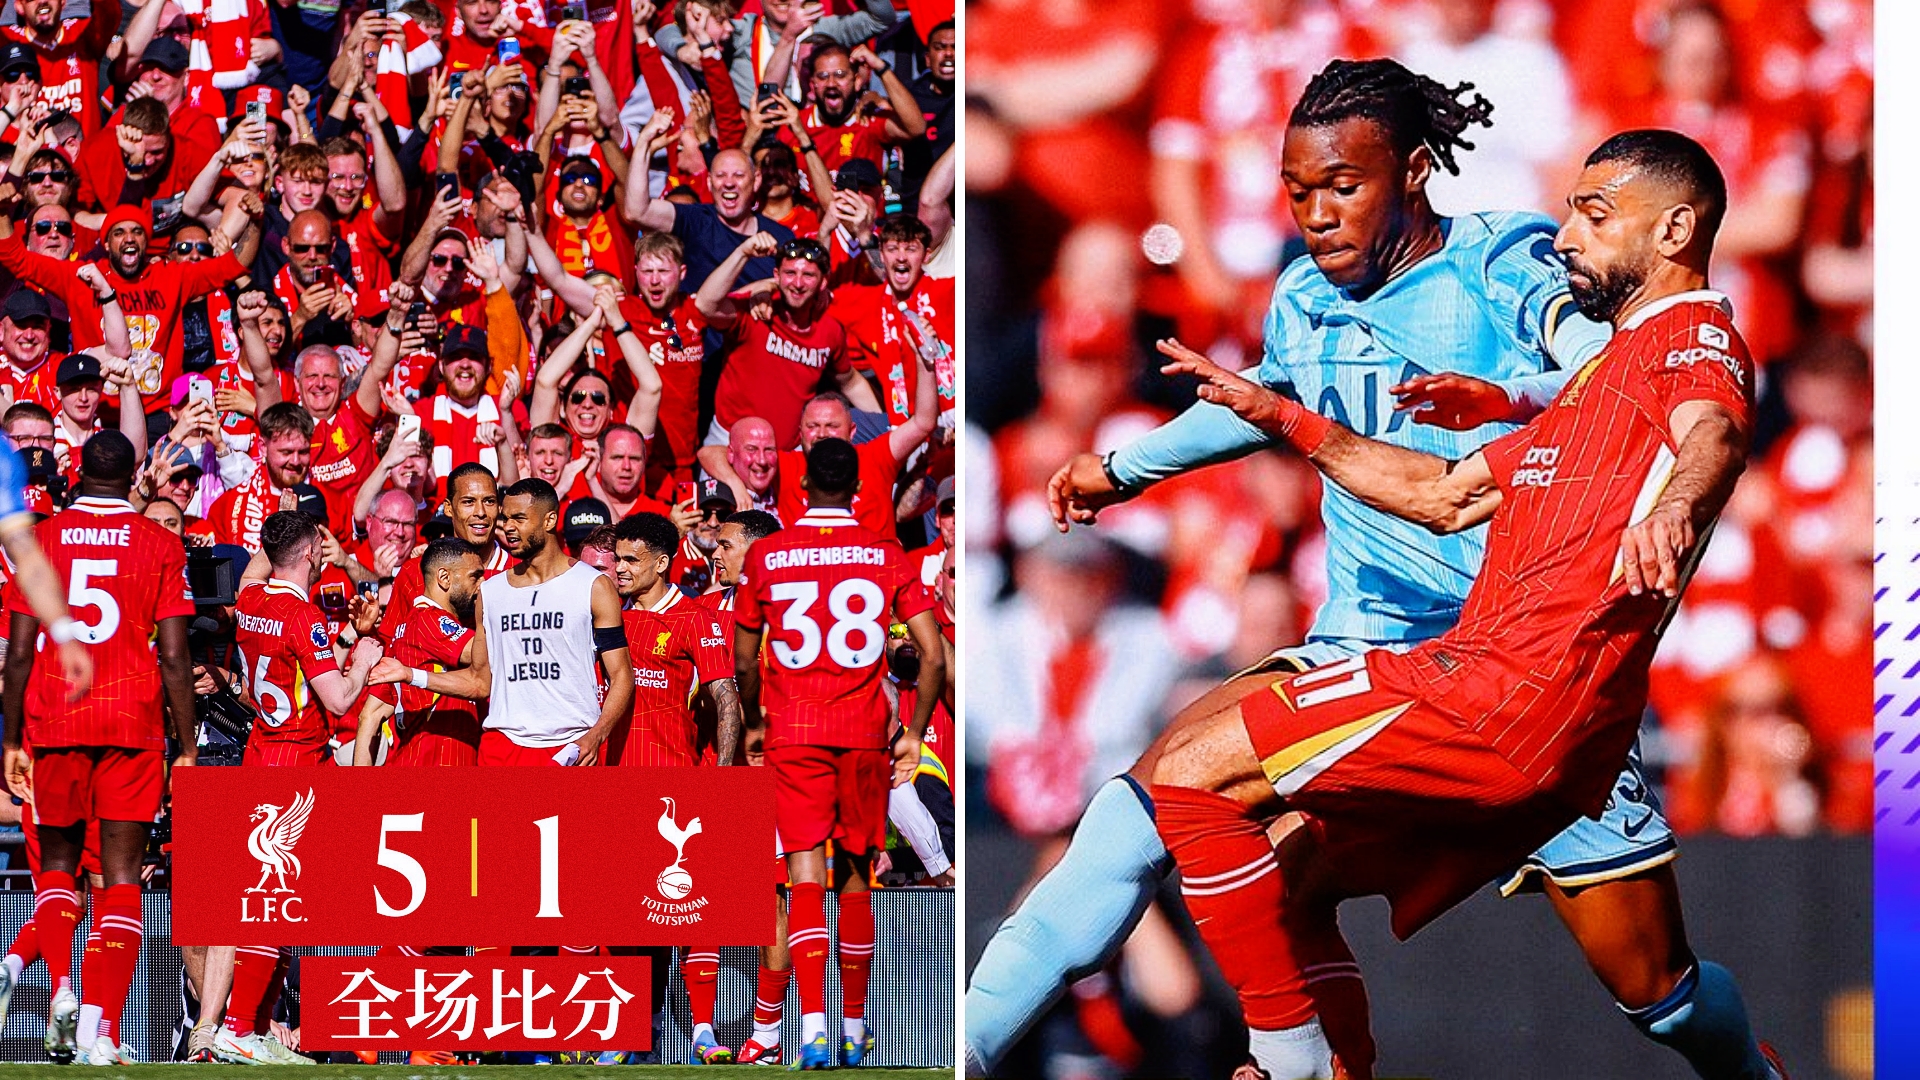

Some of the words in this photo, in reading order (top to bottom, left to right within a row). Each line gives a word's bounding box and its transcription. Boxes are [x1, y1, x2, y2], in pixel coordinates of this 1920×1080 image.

[38, 78, 82, 100] rown
[242, 493, 264, 556] EAGUE
[571, 512, 604, 526] adidas
[61, 524, 131, 547] KONATÉ
[764, 545, 885, 571] GRAVENBERCH
[68, 558, 120, 645] 5
[531, 590, 538, 607] I
[235, 609, 284, 637] OBERTSON
[501, 611, 564, 633] BELONG
[770, 577, 886, 670] 38
[521, 637, 543, 656] TO
[508, 662, 561, 683] JESUS
[1293, 653, 1373, 709] 11
